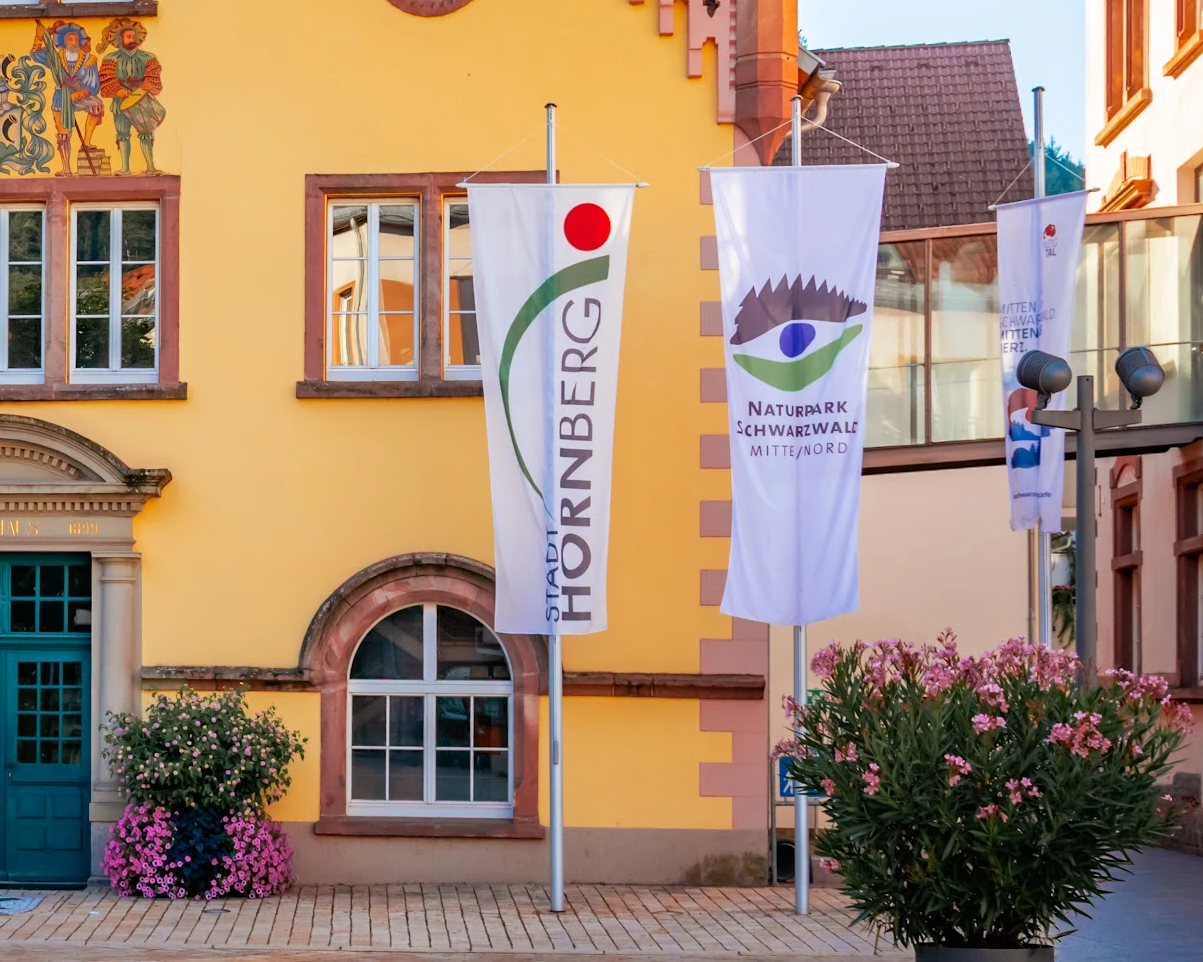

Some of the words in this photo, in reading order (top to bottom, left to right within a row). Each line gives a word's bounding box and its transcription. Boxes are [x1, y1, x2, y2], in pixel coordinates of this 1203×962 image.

[748, 401, 848, 418] NATURPARK
[737, 420, 859, 438] SCHWARZWALD
[559, 298, 602, 622] HORNBERG
[750, 442, 848, 460] MITTE/NORD
[545, 526, 560, 623] STADT
